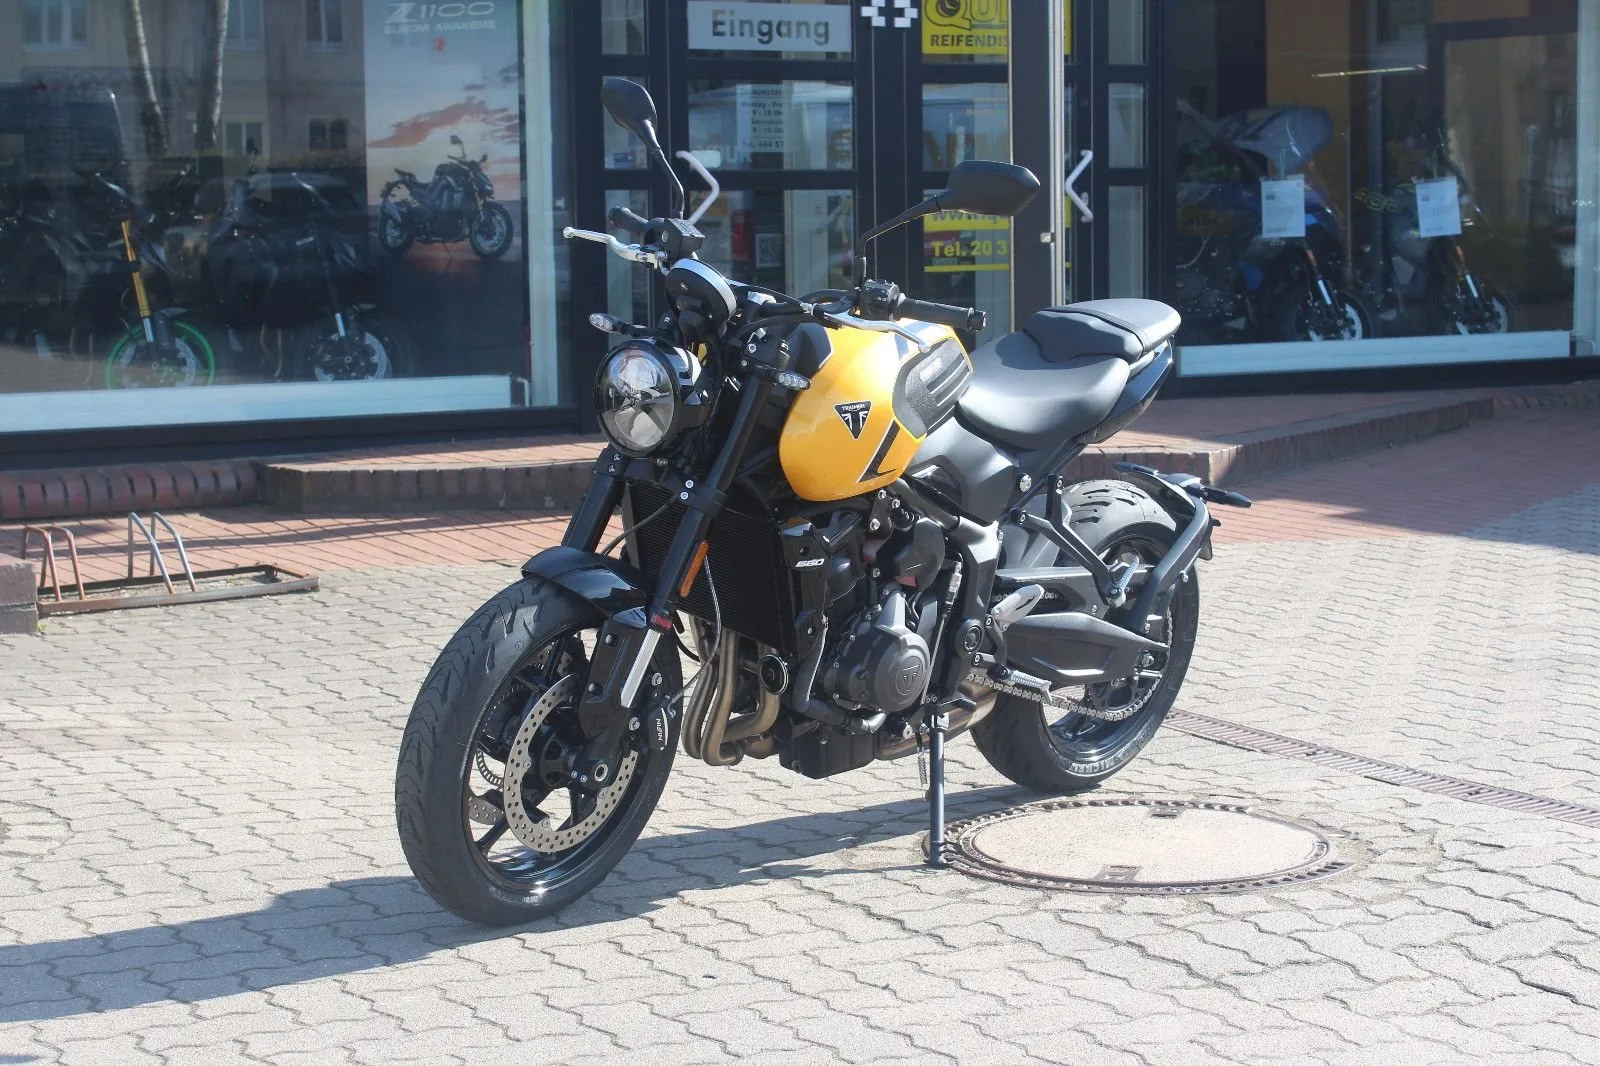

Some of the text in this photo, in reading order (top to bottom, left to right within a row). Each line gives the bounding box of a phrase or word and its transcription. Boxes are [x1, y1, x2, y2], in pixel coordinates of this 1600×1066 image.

[384, 1, 495, 23] Z1100
[711, 9, 830, 46] Eingang
[931, 241, 967, 257] Tel.
[970, 240, 993, 256] 20
